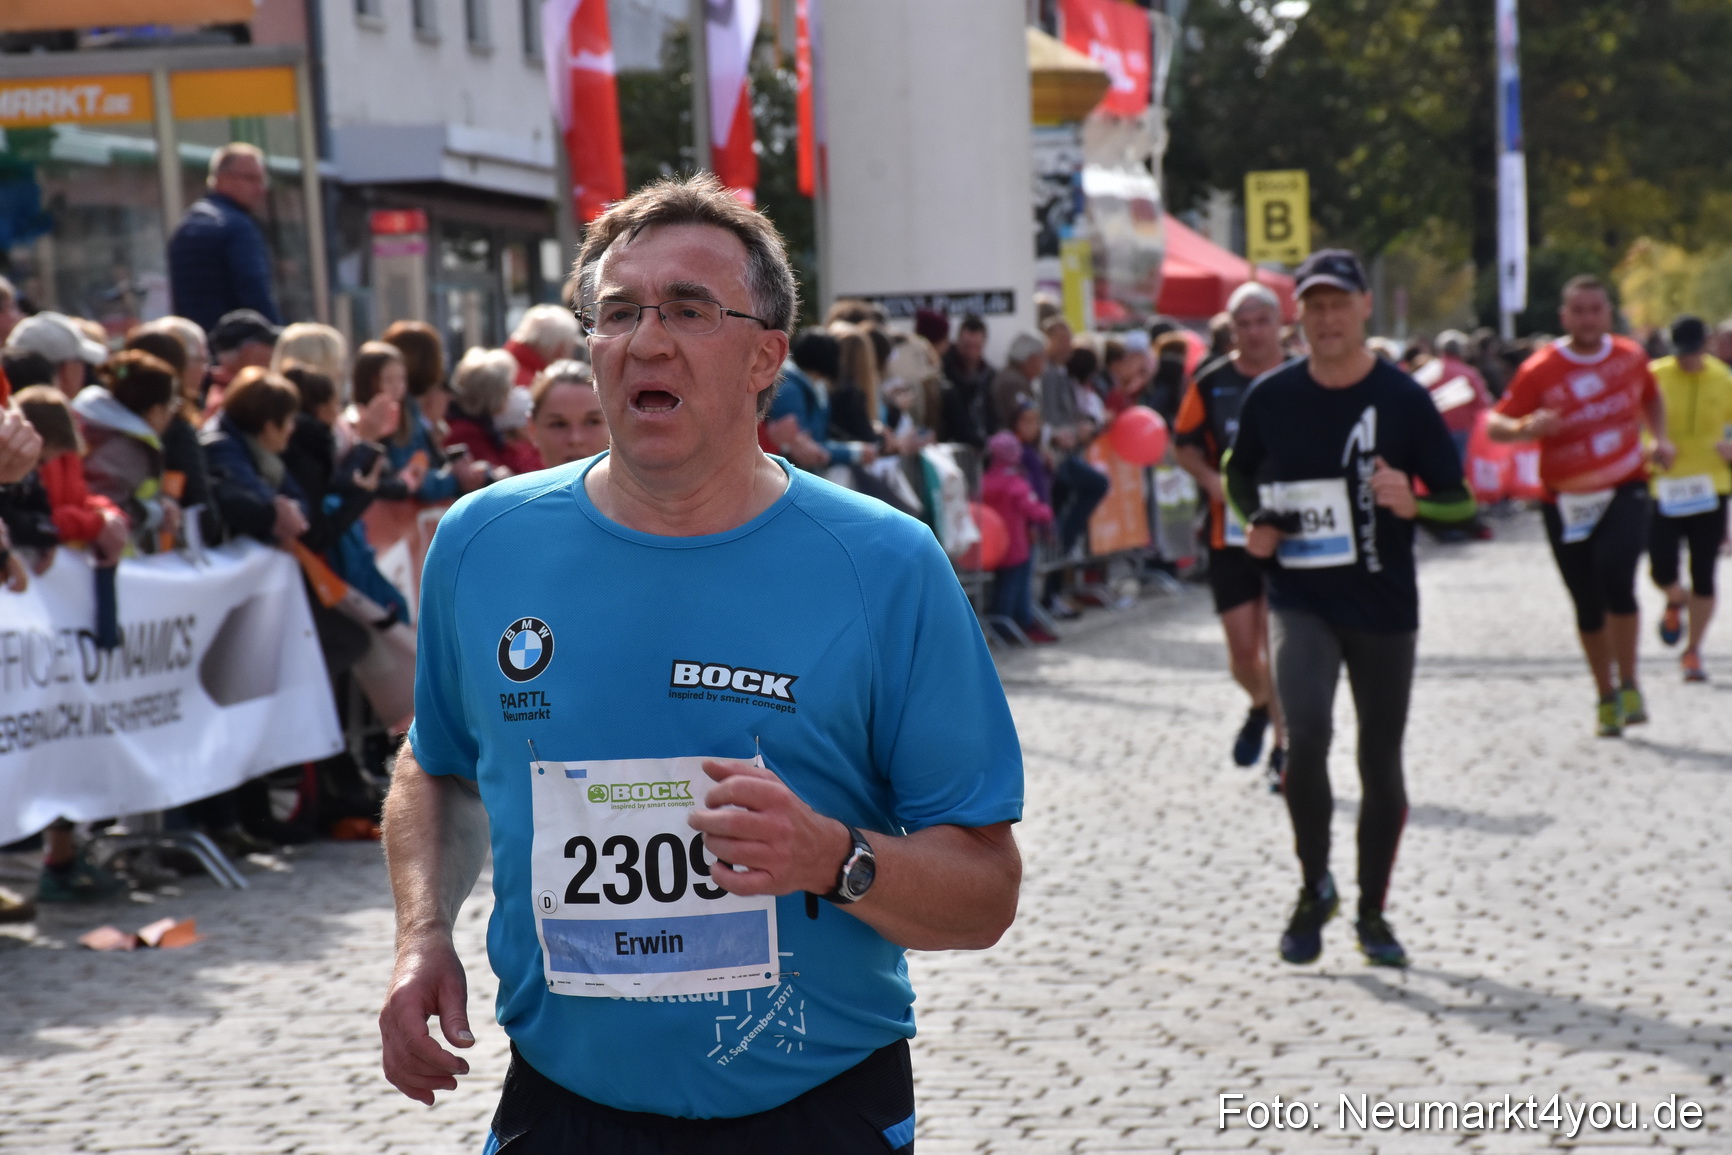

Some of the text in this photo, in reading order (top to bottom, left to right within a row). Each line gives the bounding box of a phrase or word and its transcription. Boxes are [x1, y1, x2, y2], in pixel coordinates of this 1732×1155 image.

[1264, 200, 1293, 242] B
[1303, 505, 1336, 533] 94
[671, 660, 799, 704] BOCK
[500, 691, 551, 709] PARTL
[668, 689, 797, 714] inspired by smart concepts
[503, 708, 551, 722] Neumarkt
[610, 780, 693, 803] BOCK
[611, 803, 636, 811] inspired
[667, 800, 696, 808] concepts
[564, 833, 733, 905] 2309
[544, 896, 552, 909] D
[614, 929, 684, 956] Erwin
[773, 984, 794, 1011] 2017
